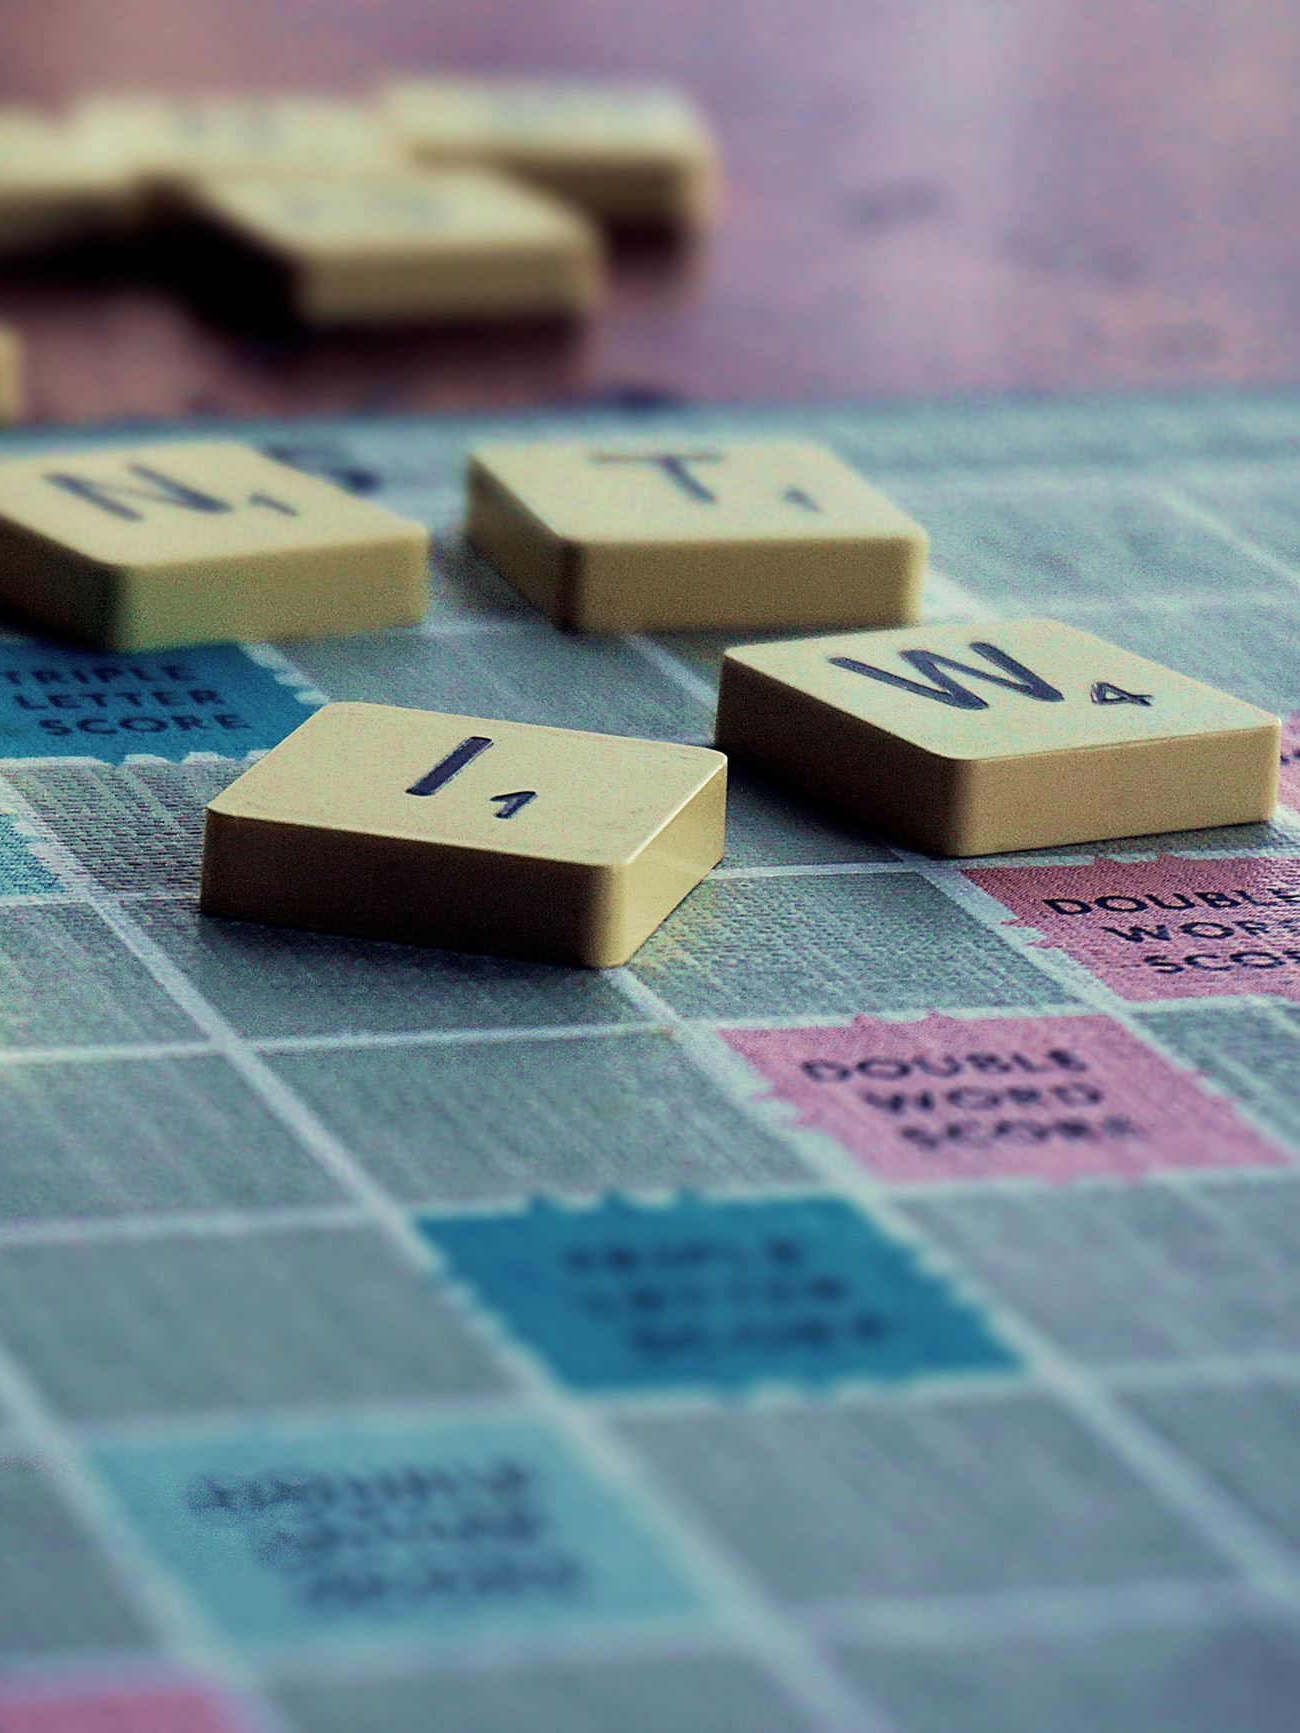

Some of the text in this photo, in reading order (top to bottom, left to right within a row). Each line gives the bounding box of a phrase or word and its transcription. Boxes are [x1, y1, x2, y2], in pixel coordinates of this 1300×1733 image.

[45, 463, 235, 523] N
[588, 453, 723, 505] T
[827, 640, 1154, 711] W 4
[12, 688, 227, 711] LETTER
[38, 712, 250, 737] SCORE
[801, 1048, 1088, 1084] DOUBLE
